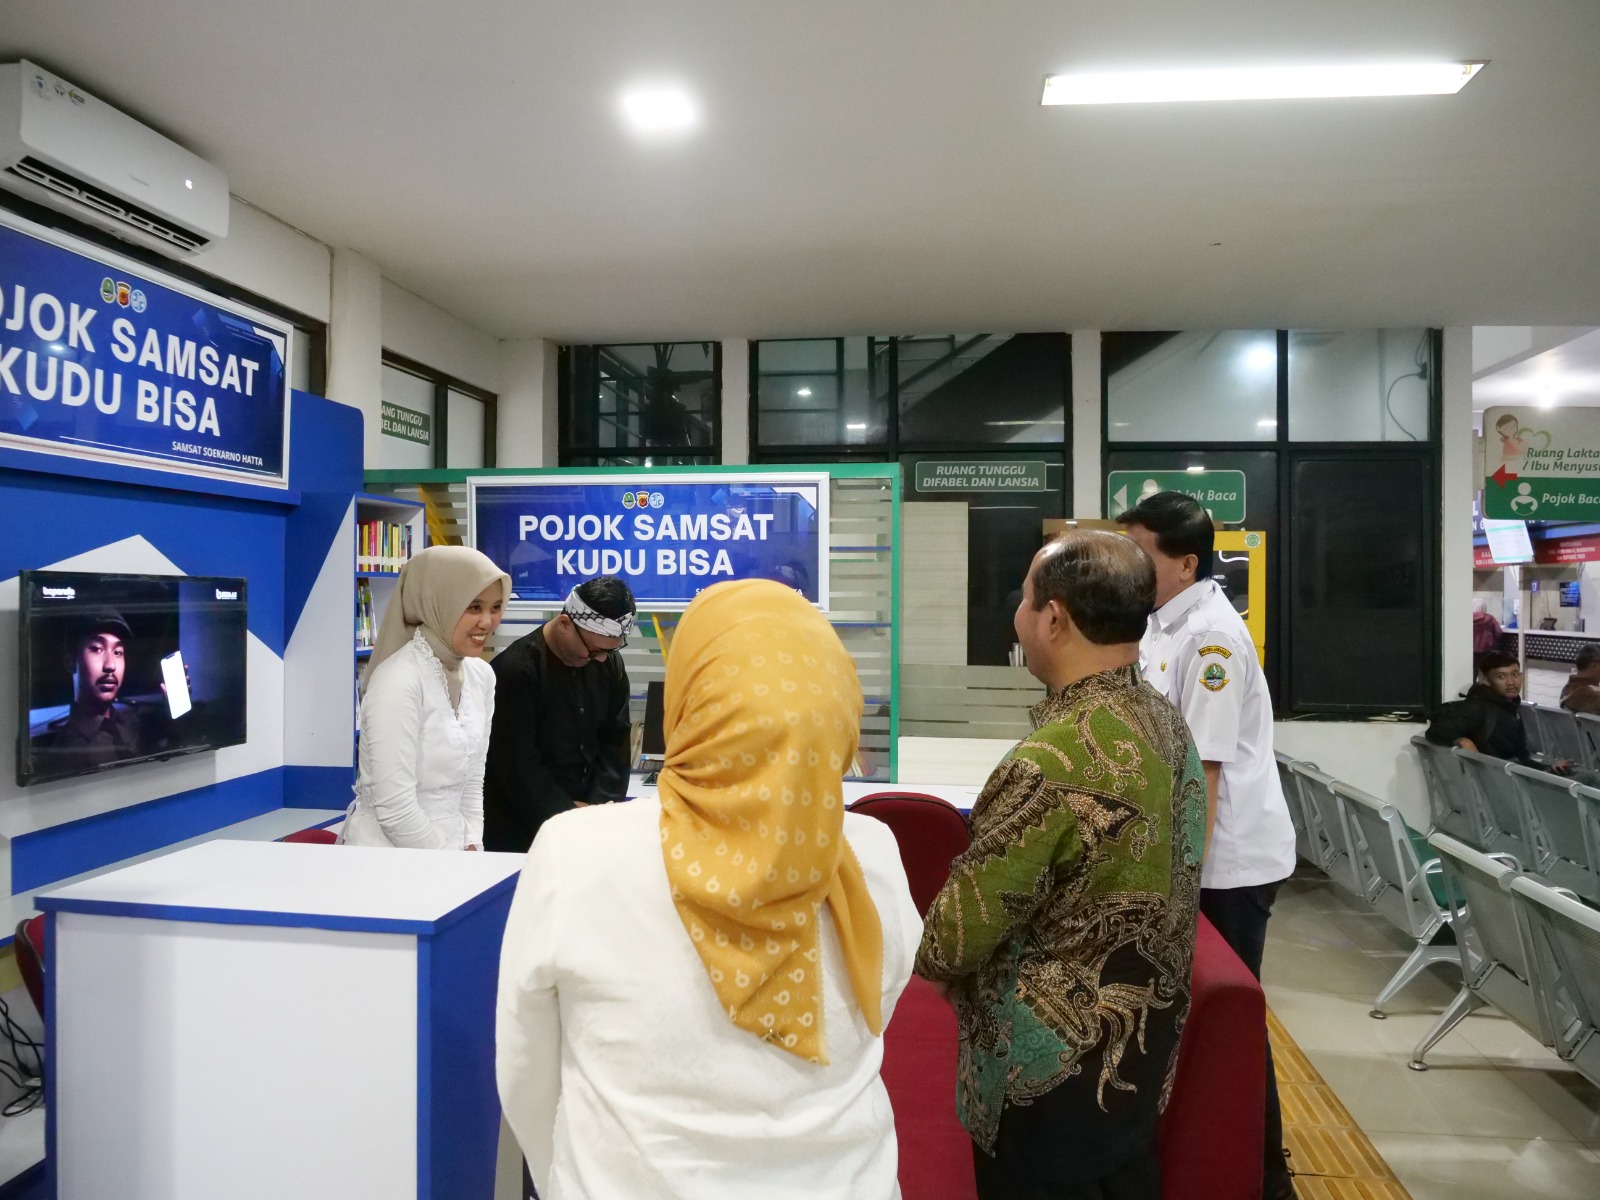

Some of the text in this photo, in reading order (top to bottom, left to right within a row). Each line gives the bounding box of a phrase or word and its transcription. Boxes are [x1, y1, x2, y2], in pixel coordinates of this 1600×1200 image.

[110, 317, 260, 397] SAMSAT
[0, 343, 221, 437] KUDU BISA
[396, 409, 423, 427] TUNGGU
[392, 421, 407, 435] DAN
[407, 426, 430, 442] LANSIA
[171, 440, 264, 466] SAMSAT SOEKARNO HATTA
[1526, 447, 1564, 461] Ruang
[936, 466, 1026, 475] RUANG TUNGGU
[1530, 460, 1550, 471] Ibu
[922, 477, 1040, 487] DIFABEL DAN LANSIA
[1207, 489, 1237, 501] Baca
[1541, 492, 1600, 507] Pojok Bac
[519, 513, 774, 541] POJOK SAMSAT
[556, 549, 735, 576] KUDU BISA
